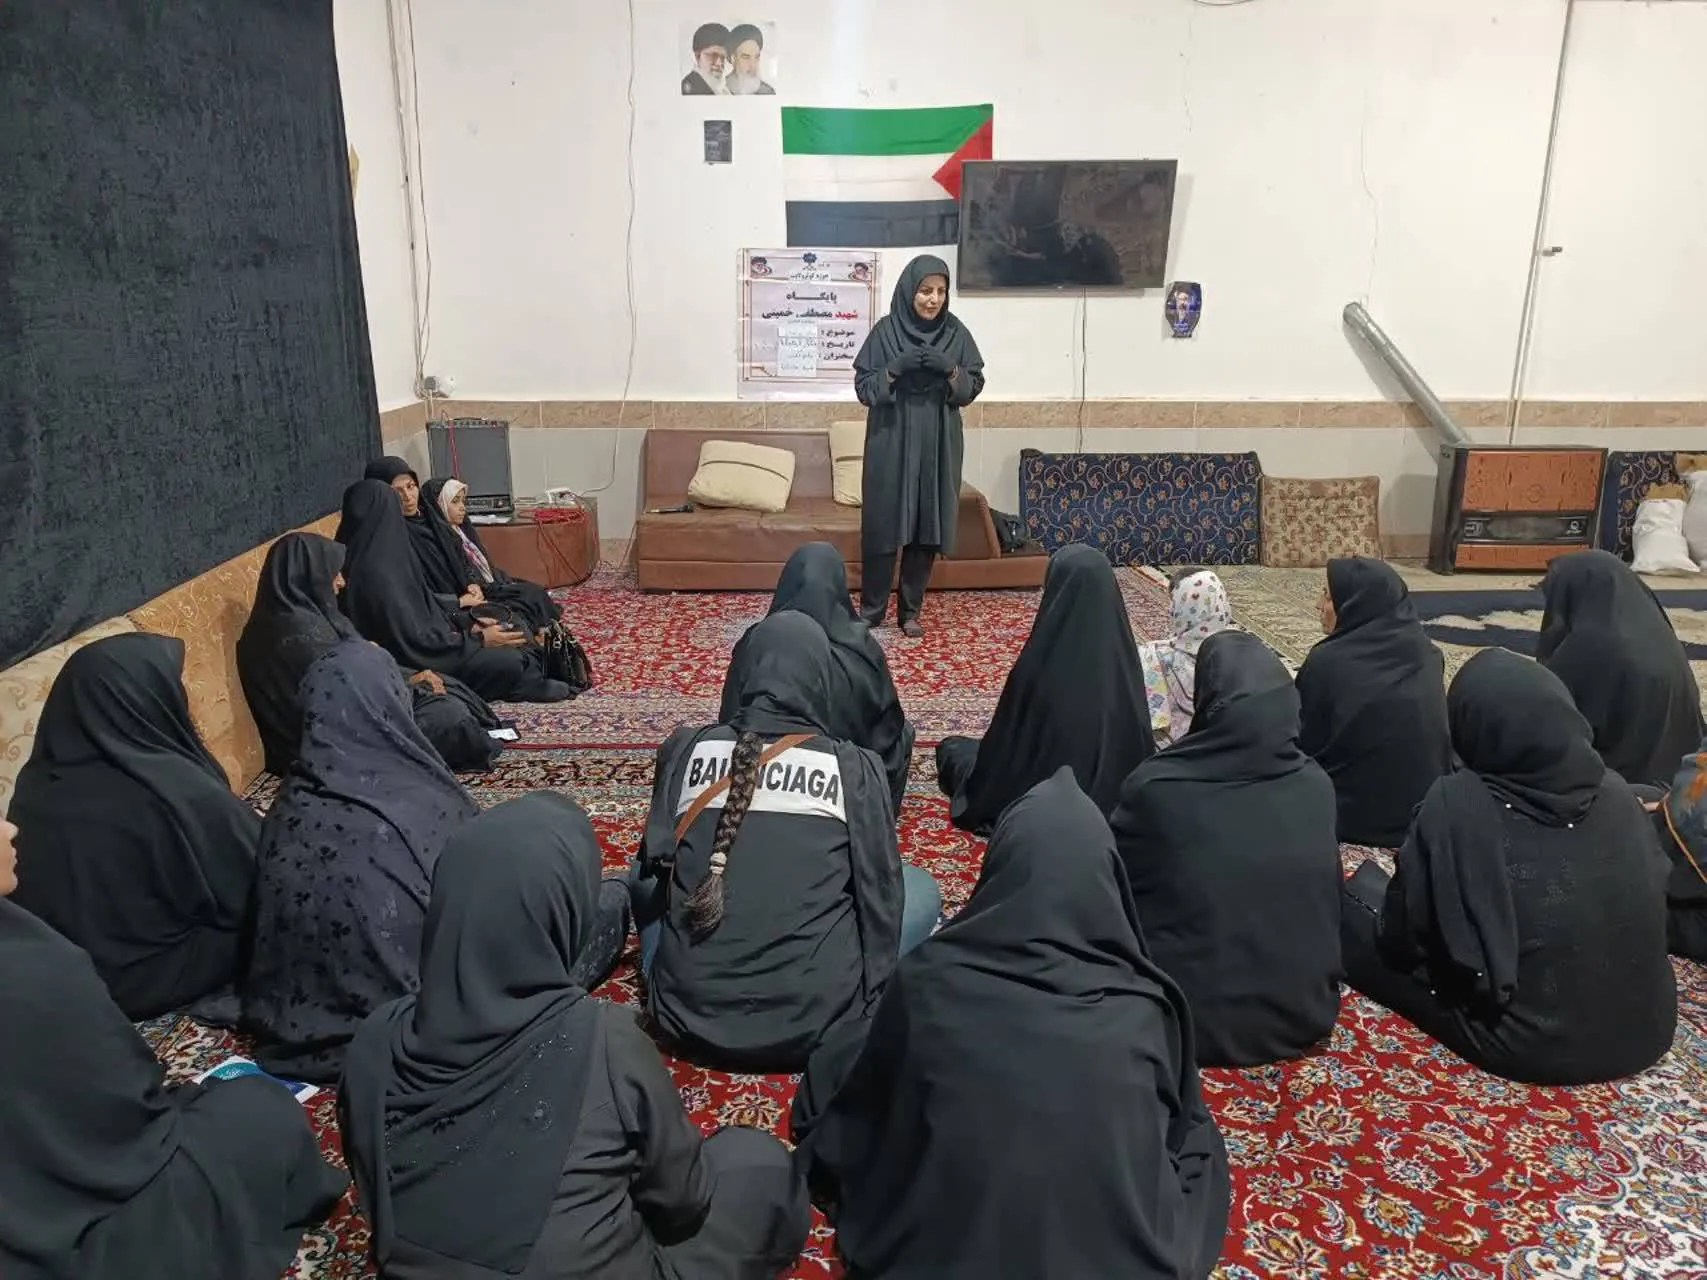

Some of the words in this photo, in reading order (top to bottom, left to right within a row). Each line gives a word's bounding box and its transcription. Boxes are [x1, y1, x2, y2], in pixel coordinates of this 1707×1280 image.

[785, 290, 837, 304] پایگاه
[761, 306, 794, 319] خمینی
[834, 309, 859, 319] شهید
[688, 757, 841, 806] BALNCIAGA
